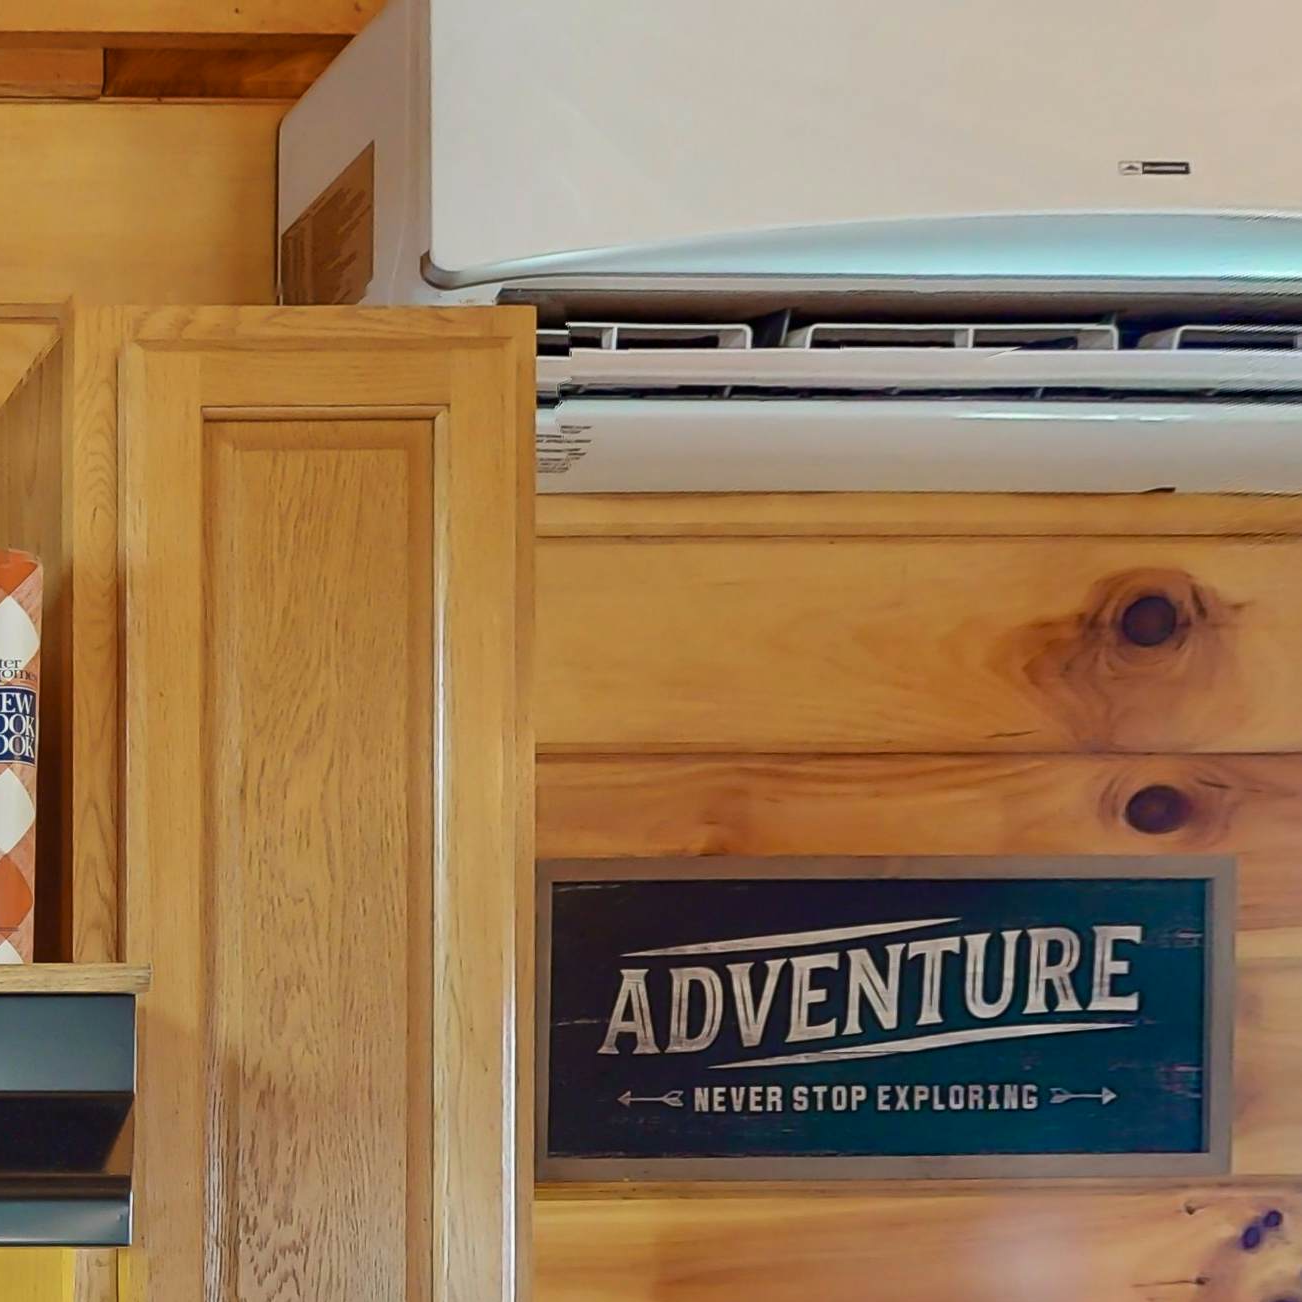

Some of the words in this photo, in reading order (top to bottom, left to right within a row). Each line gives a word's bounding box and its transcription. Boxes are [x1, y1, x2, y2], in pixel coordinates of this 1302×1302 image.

[597, 925, 1142, 1056] ADVENTURE
[694, 1085, 783, 1112] NEVER
[792, 1085, 866, 1112] STOP
[877, 1084, 1039, 1111] EXPLORING
